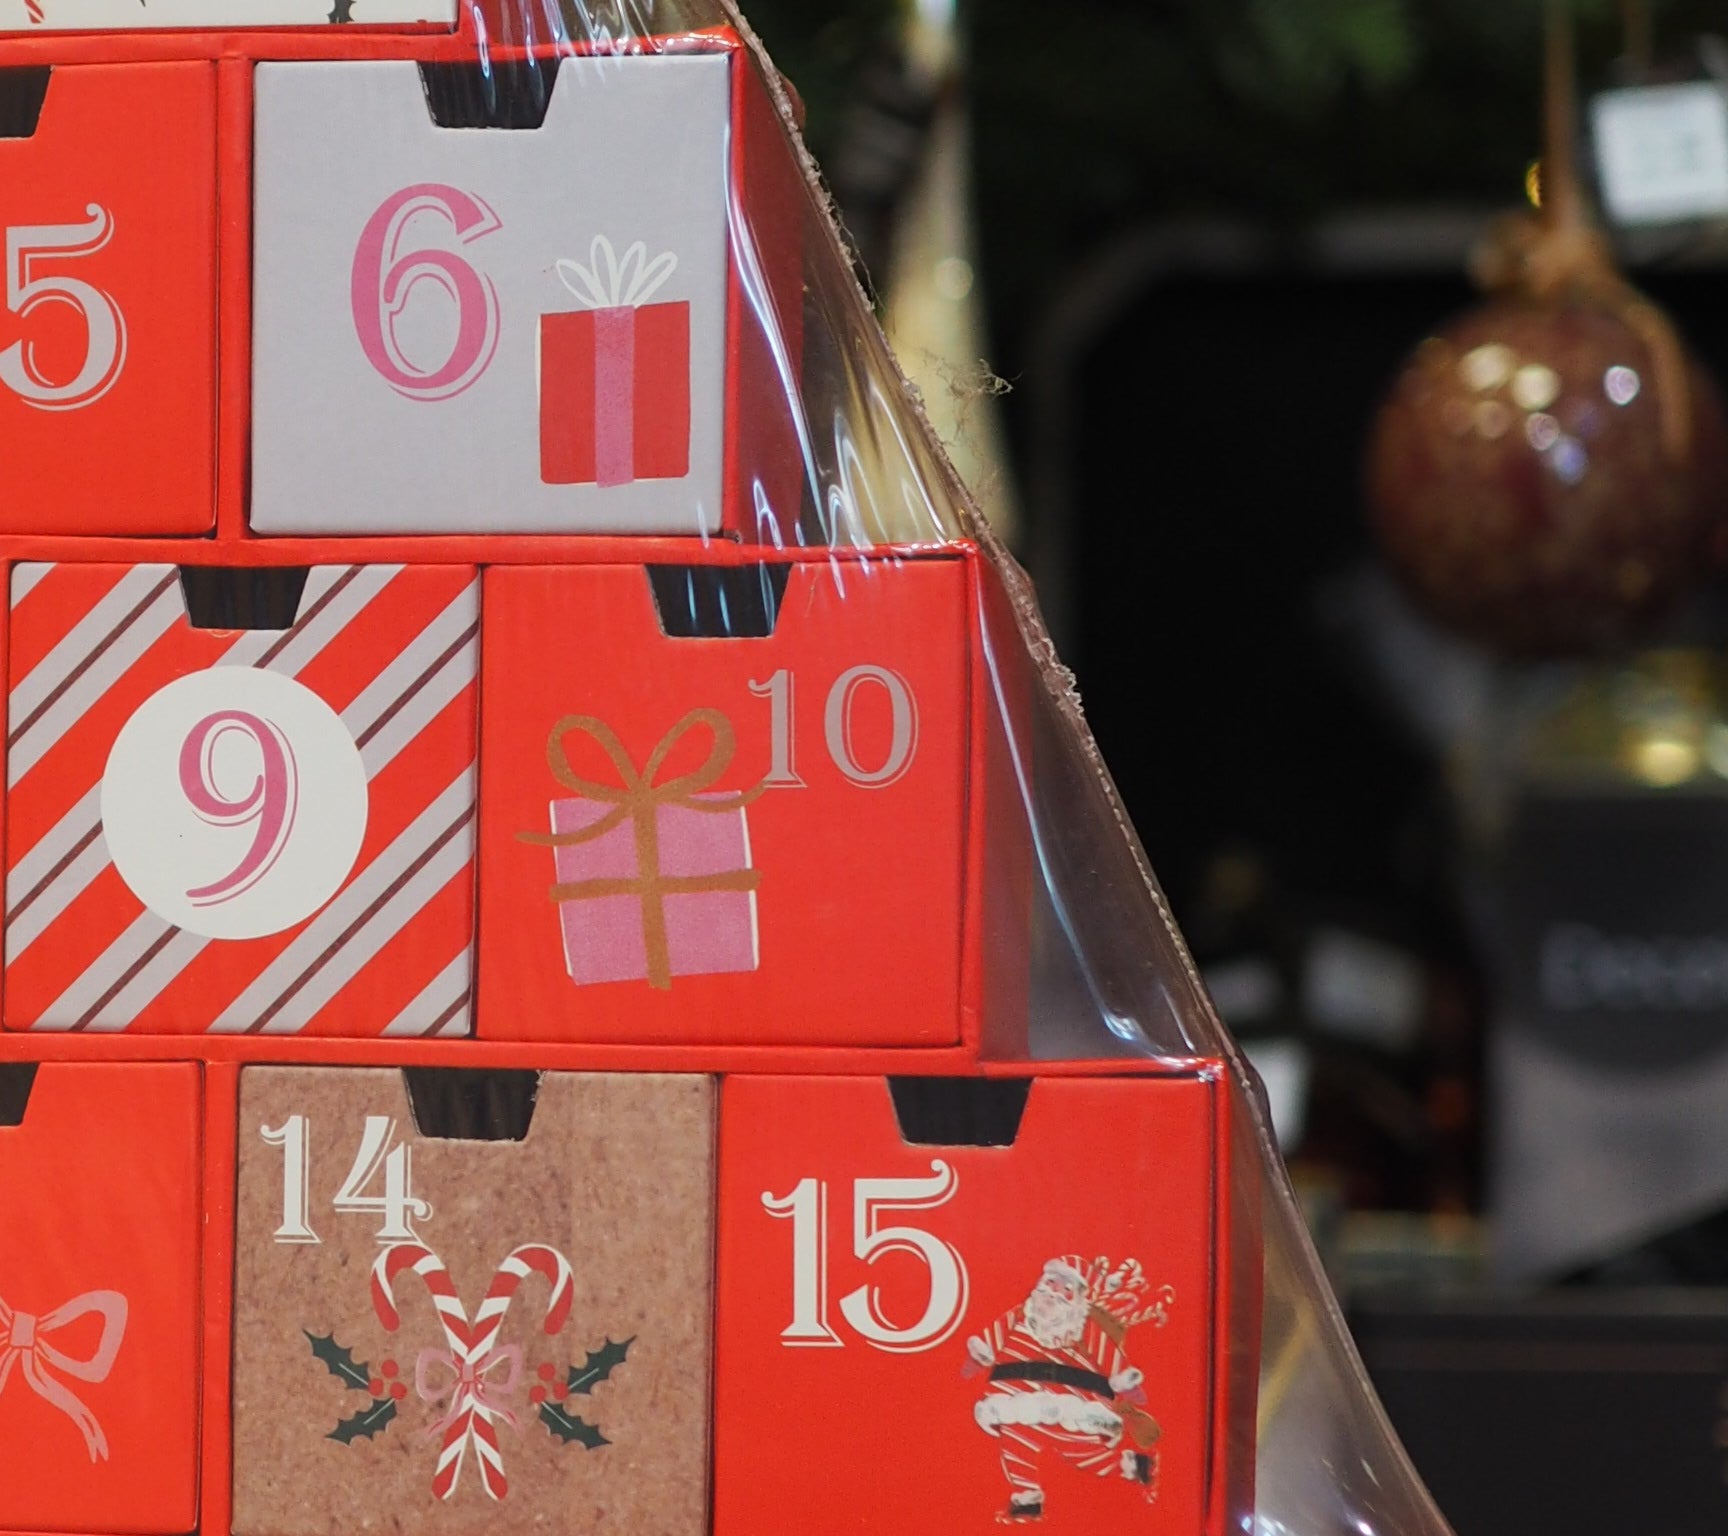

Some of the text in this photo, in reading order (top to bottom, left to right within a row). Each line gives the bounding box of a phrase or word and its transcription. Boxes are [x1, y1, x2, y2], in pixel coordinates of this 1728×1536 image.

[349, 182, 501, 402] 6
[178, 709, 299, 908] 9
[747, 665, 920, 789] 10
[260, 1114, 432, 1245] 14
[760, 1158, 970, 1353] 15
